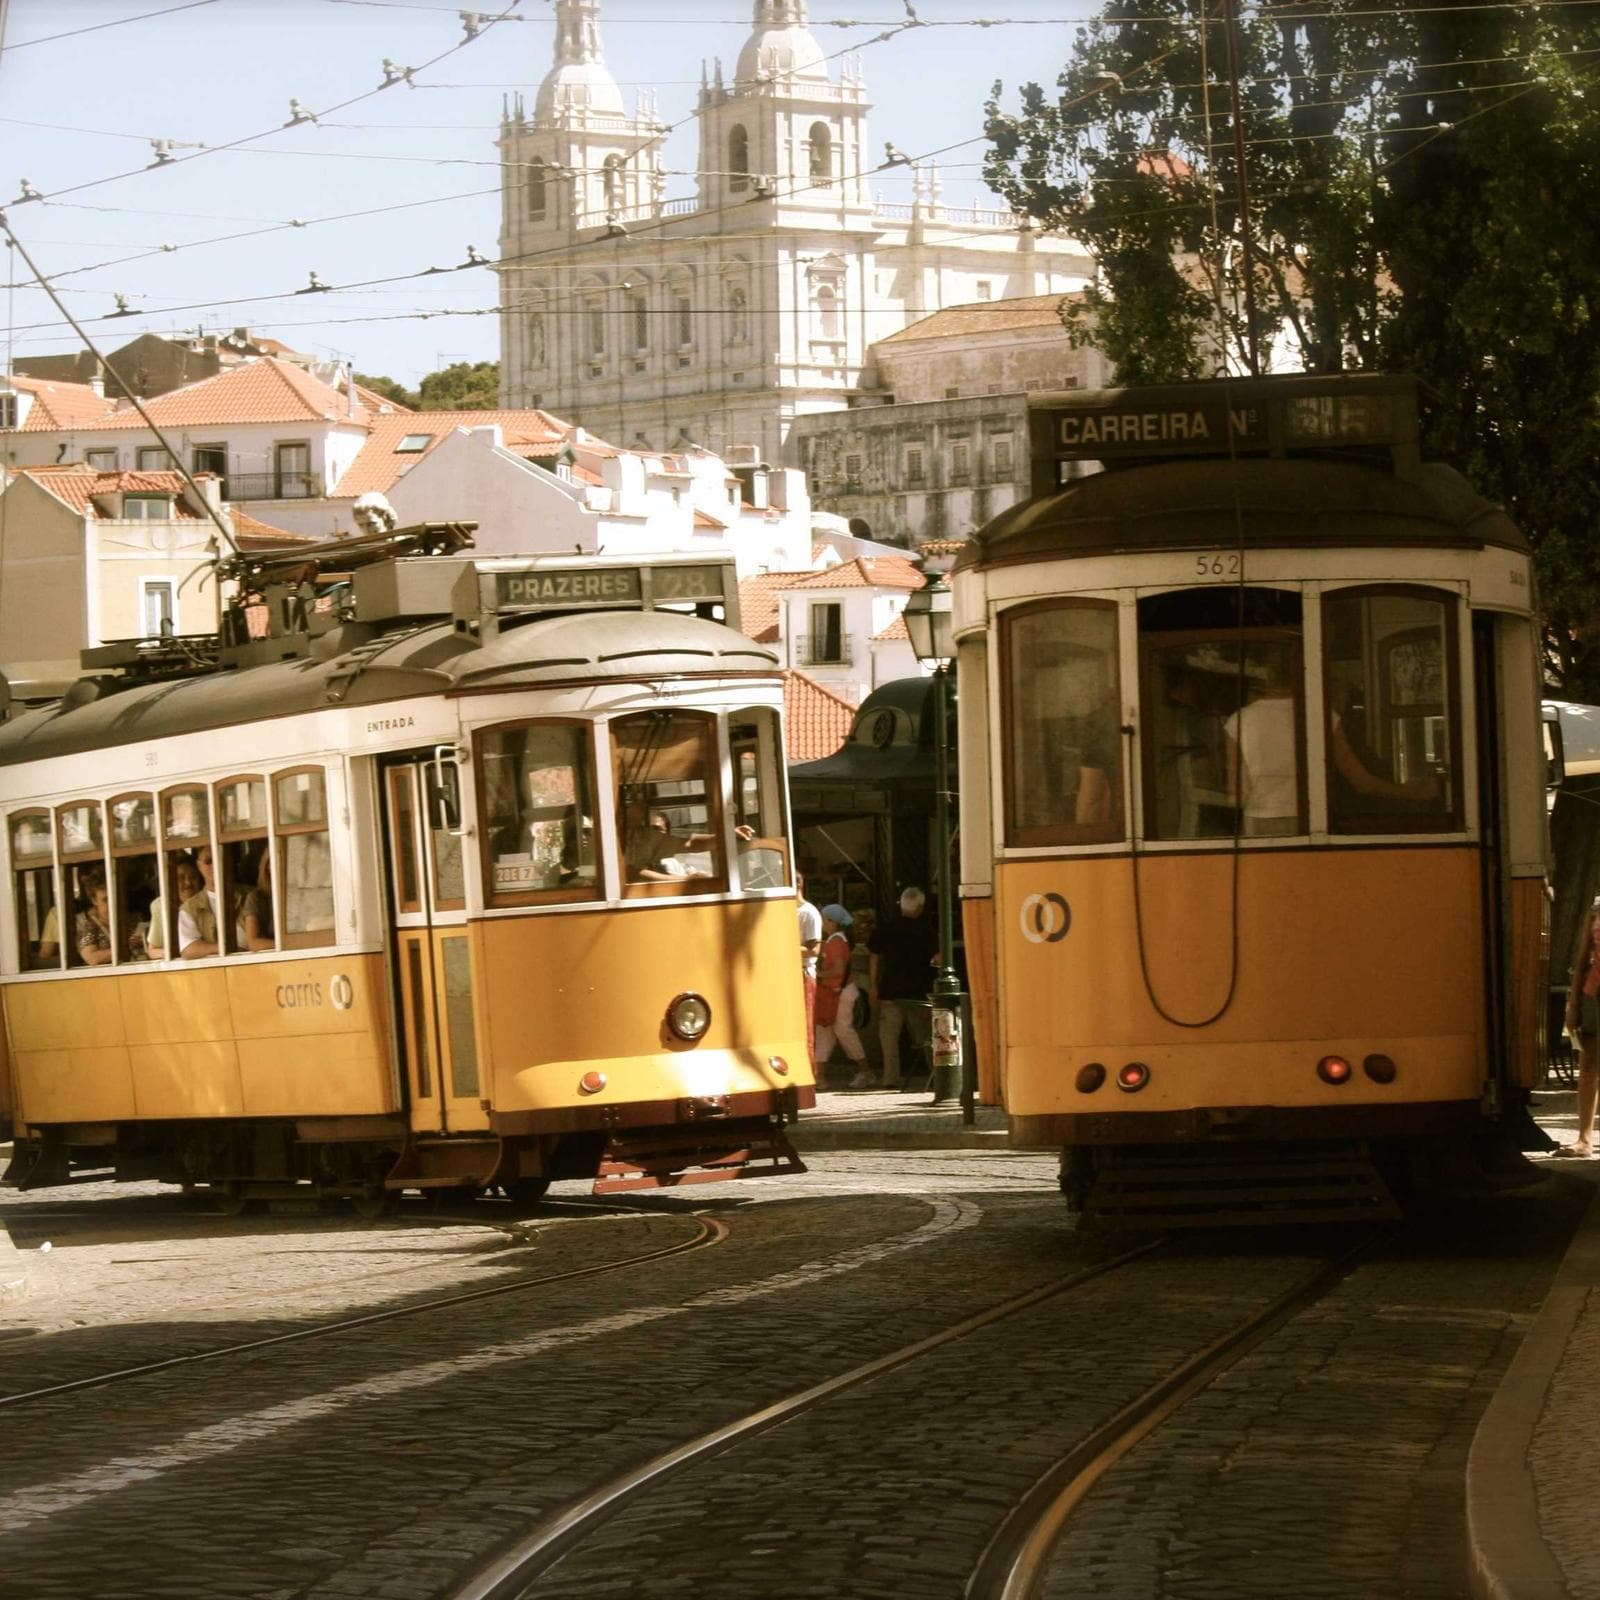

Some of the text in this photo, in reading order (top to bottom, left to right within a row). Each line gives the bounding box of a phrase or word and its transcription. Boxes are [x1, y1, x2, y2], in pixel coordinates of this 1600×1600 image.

[1060, 411, 1210, 445] CARREIRA
[1196, 554, 1240, 576] 562
[507, 571, 708, 600] PRAZERES 28
[367, 716, 415, 733] ENTRADA
[275, 971, 323, 1009] carris
